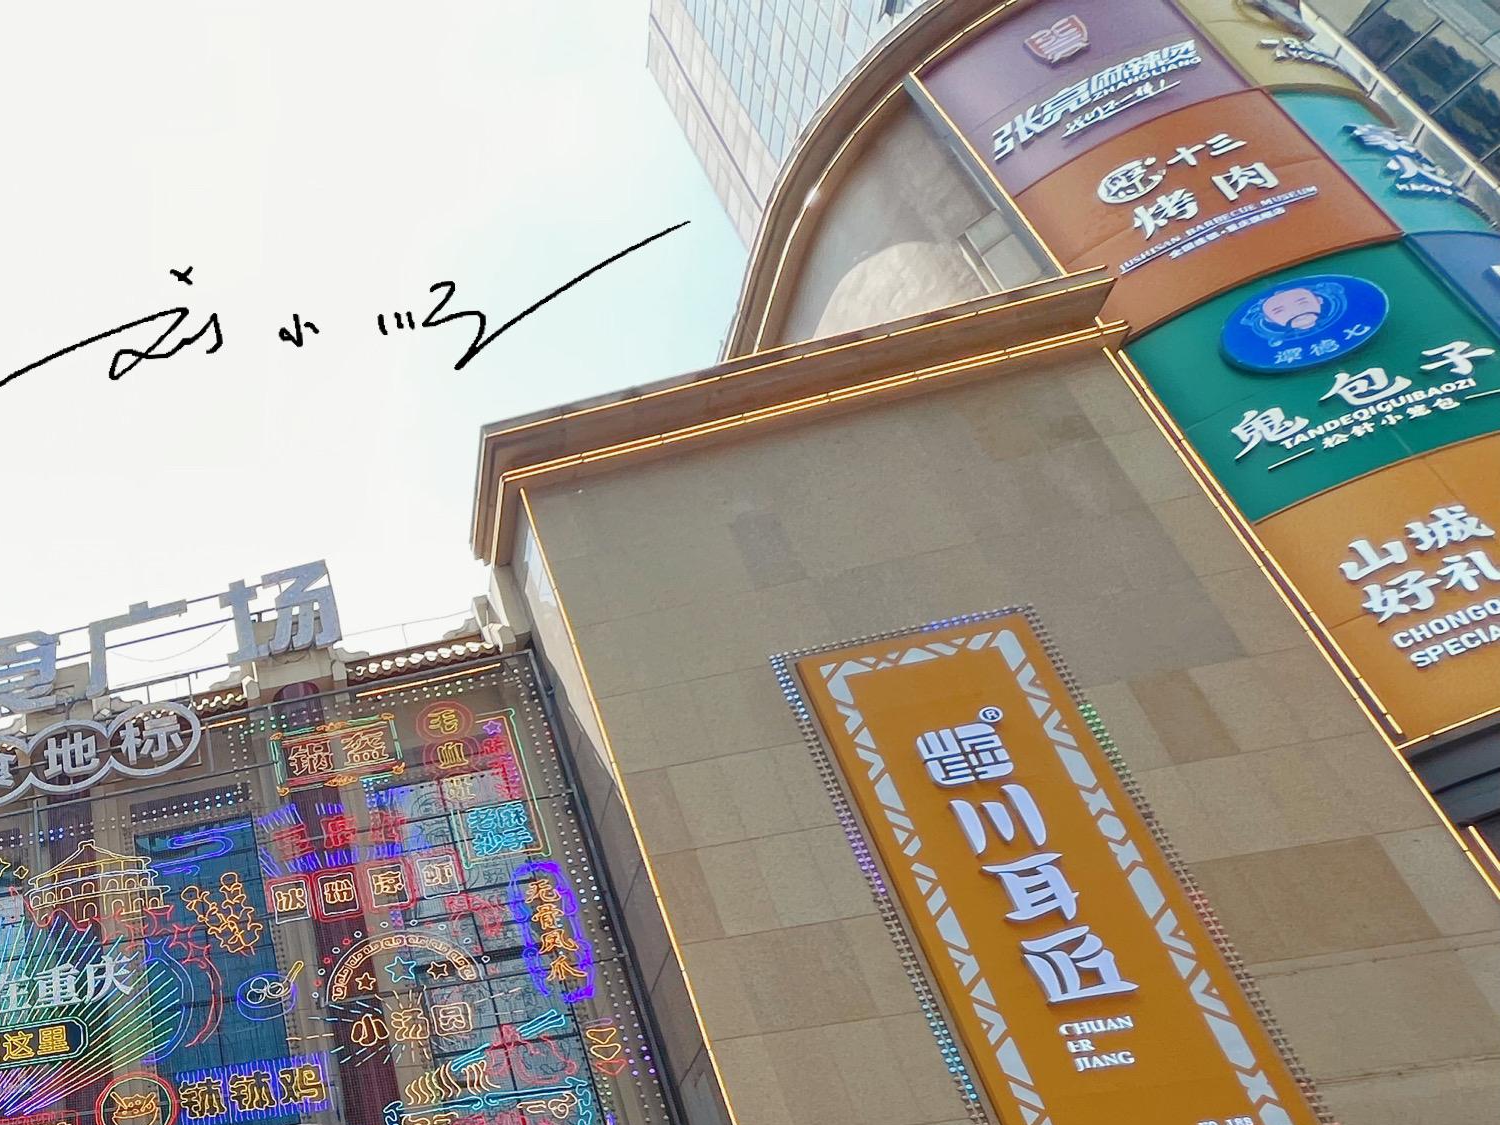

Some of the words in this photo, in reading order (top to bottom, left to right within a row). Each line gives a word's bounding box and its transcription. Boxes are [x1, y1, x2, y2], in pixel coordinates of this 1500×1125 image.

[1090, 56, 1202, 101] ZHANGLIANG
[1133, 162, 1279, 240] 烤肉
[1186, 202, 1257, 237] BARBECUE
[1260, 185, 1318, 210] MUSEUM
[1231, 340, 1495, 461] 鬼包子
[1279, 376, 1477, 450] TANDEQIGUIBAOZI
[1339, 505, 1496, 582] 山城
[1361, 550, 1500, 625] 好礼
[1059, 1015, 1135, 1038] CHUAN
[1074, 1050, 1136, 1072] JIANG
